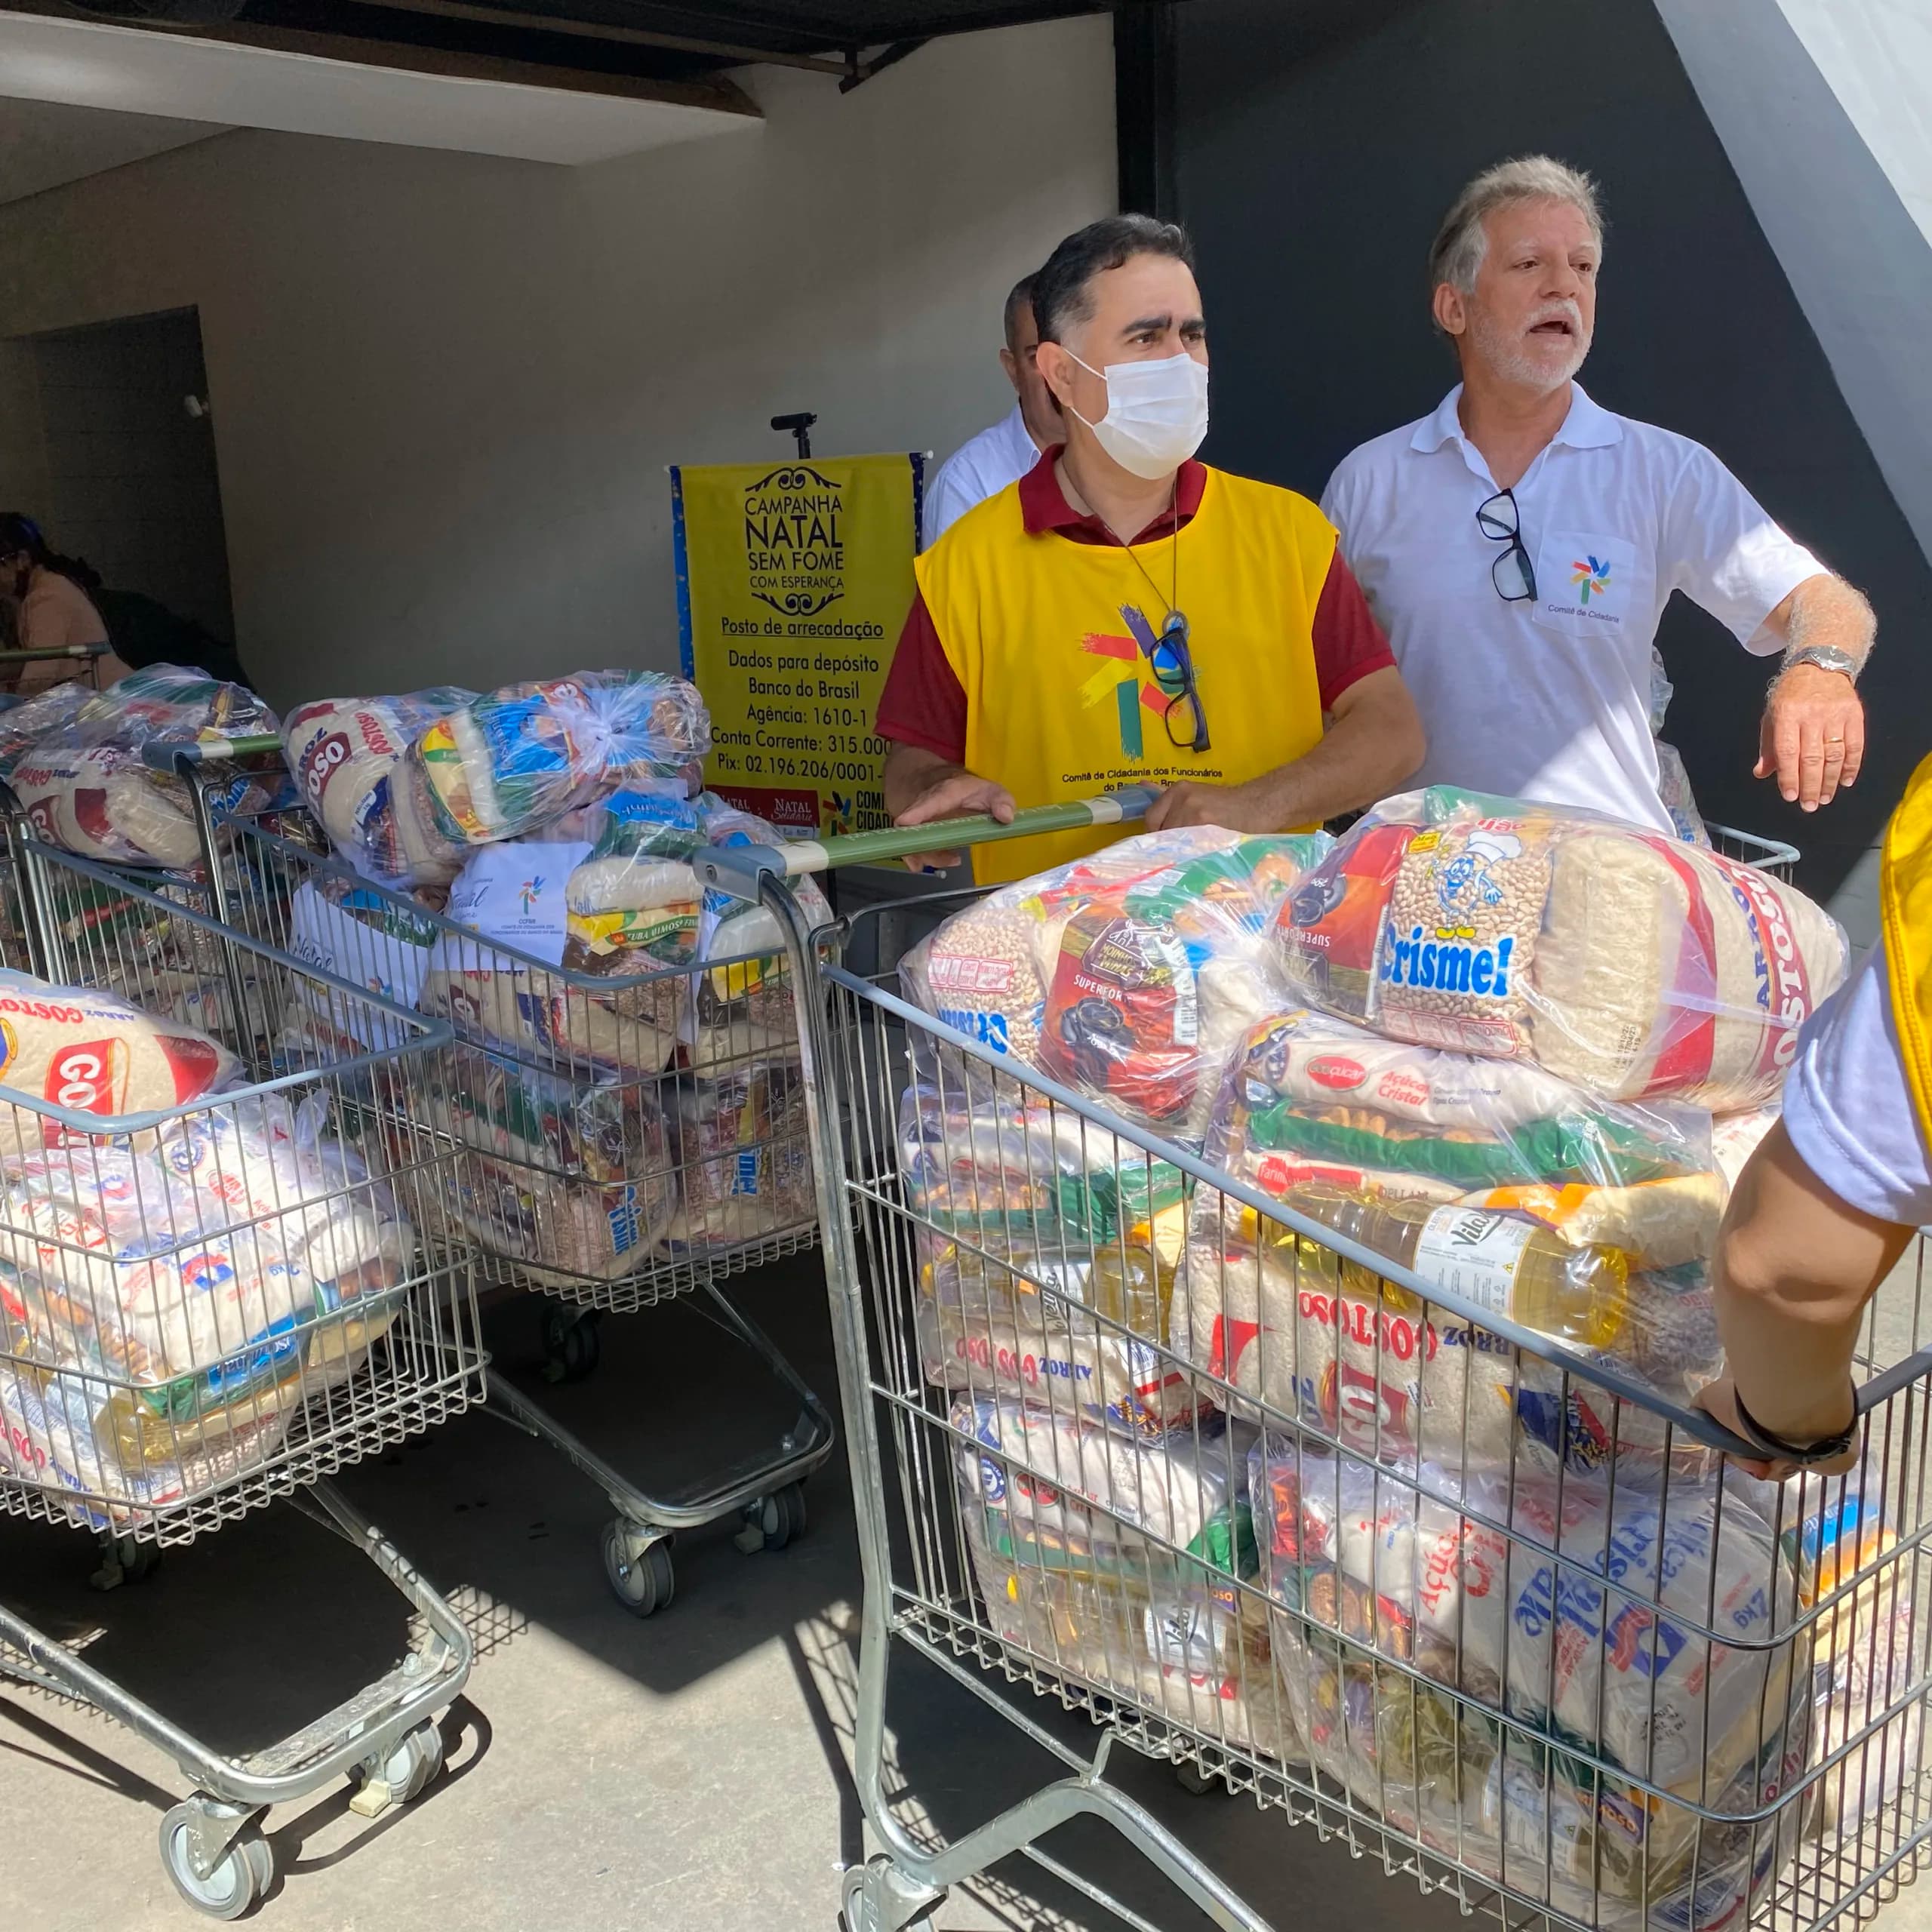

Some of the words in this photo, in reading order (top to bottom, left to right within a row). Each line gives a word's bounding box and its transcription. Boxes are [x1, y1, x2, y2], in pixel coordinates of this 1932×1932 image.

[745, 495, 843, 515] CAMPANHA
[745, 514, 843, 549] NATAL
[748, 552, 786, 571] SEM
[792, 551, 844, 571] FOME
[749, 576, 778, 589] COM
[781, 575, 844, 592] ESPERANÇA
[721, 617, 758, 635] Posto
[764, 617, 783, 635] de
[787, 621, 884, 641] arrecadação
[728, 650, 773, 669] Dados
[777, 655, 809, 672] para
[814, 654, 879, 678] depósito
[749, 678, 792, 697] Banco
[796, 680, 813, 697] do
[819, 681, 860, 700] Brasil
[747, 703, 808, 726] Agência:
[814, 707, 867, 727] 1610-1
[711, 727, 751, 746] Conta
[755, 730, 822, 751] Corrente:
[718, 752, 740, 771] Pix:
[1094, 771, 1105, 780] de
[1107, 769, 1151, 779] Cidadania
[1153, 768, 1169, 776] dos
[1171, 767, 1223, 778] Funcionários
[1104, 783, 1115, 792] do
[774, 798, 811, 812] NATAL
[857, 791, 884, 811] COMI
[857, 811, 891, 829] CIDAD
[1073, 974, 1132, 1006] SUPERFOR
[0, 998, 84, 1024] GOSTO
[1378, 1083, 1426, 1106] Cristal
[1443, 1324, 1509, 1356] RROZ
[955, 1336, 1038, 1388] GOSOSO
